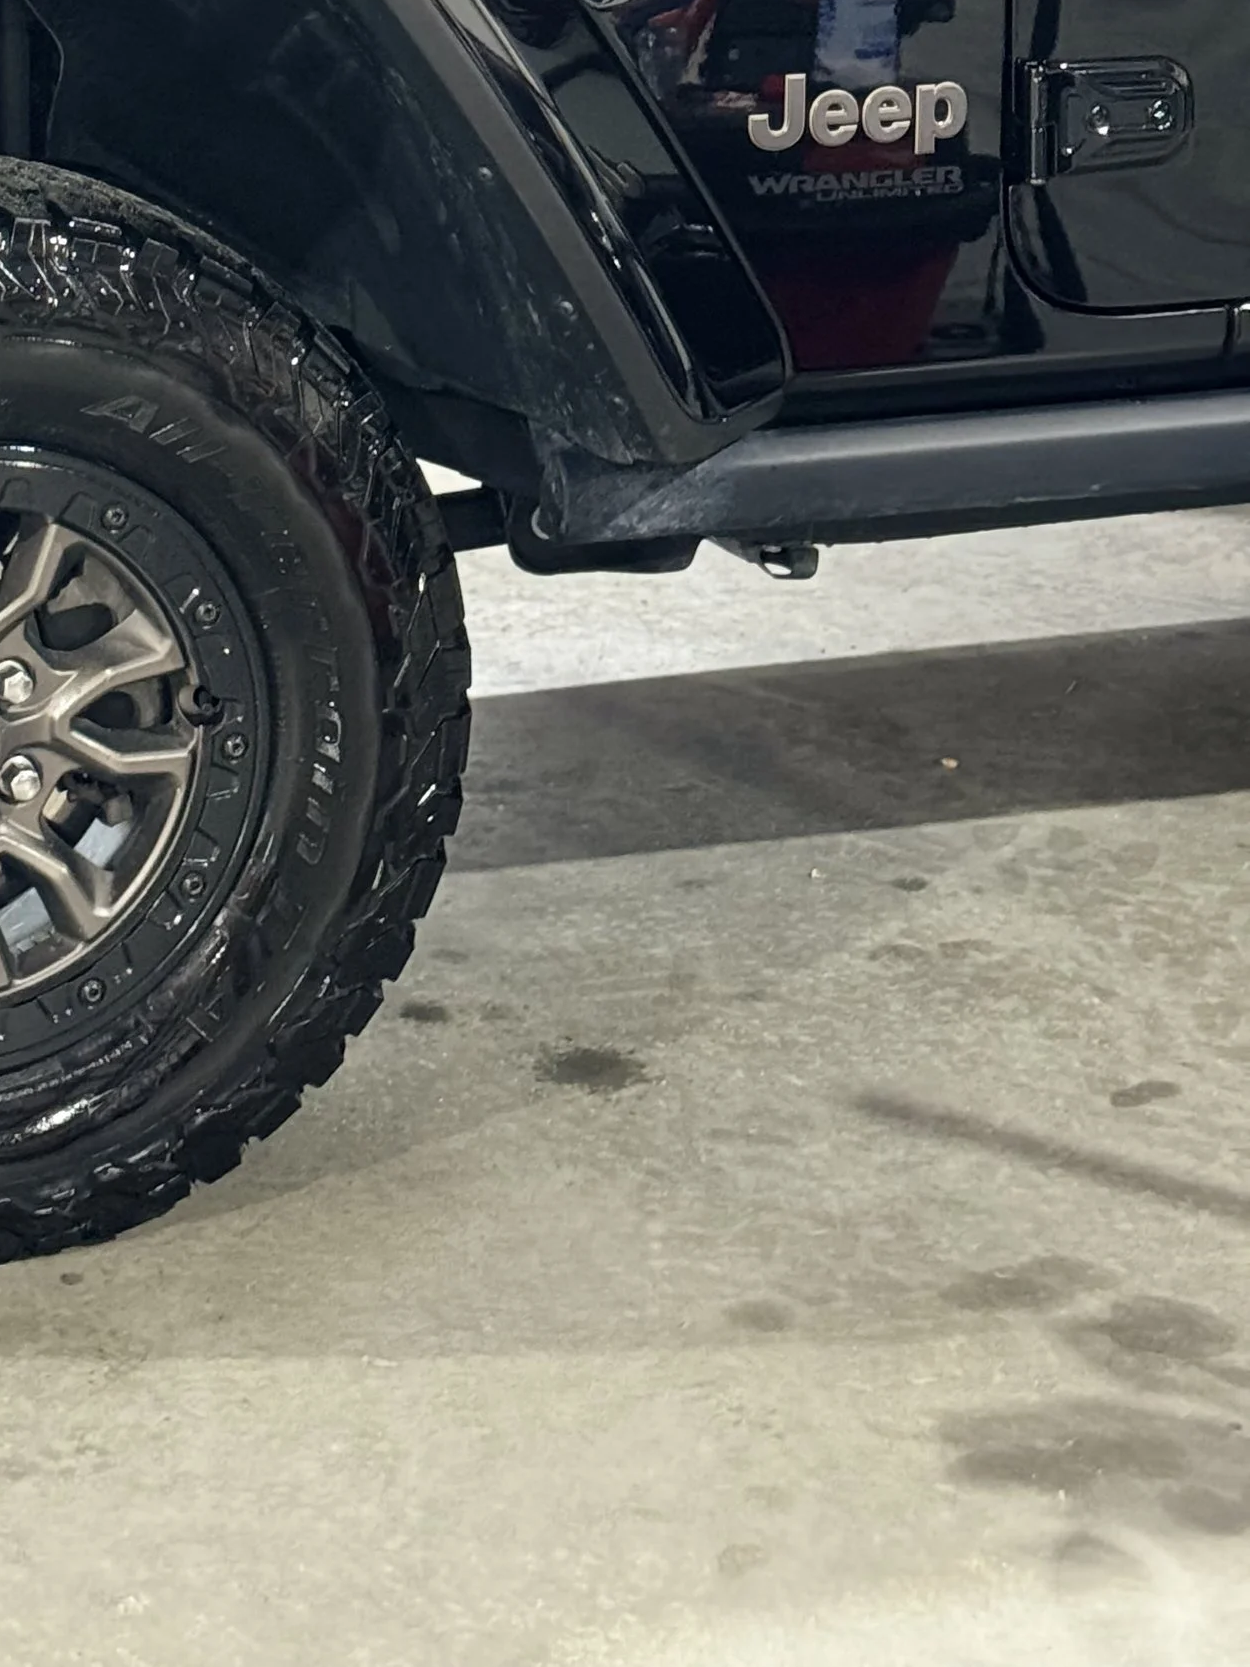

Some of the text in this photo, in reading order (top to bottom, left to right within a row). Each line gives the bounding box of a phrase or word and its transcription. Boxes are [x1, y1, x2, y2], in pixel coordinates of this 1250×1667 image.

[747, 72, 968, 155] Jeep
[747, 165, 963, 196] WRANGLER
[815, 181, 965, 202] UNLIMITED
